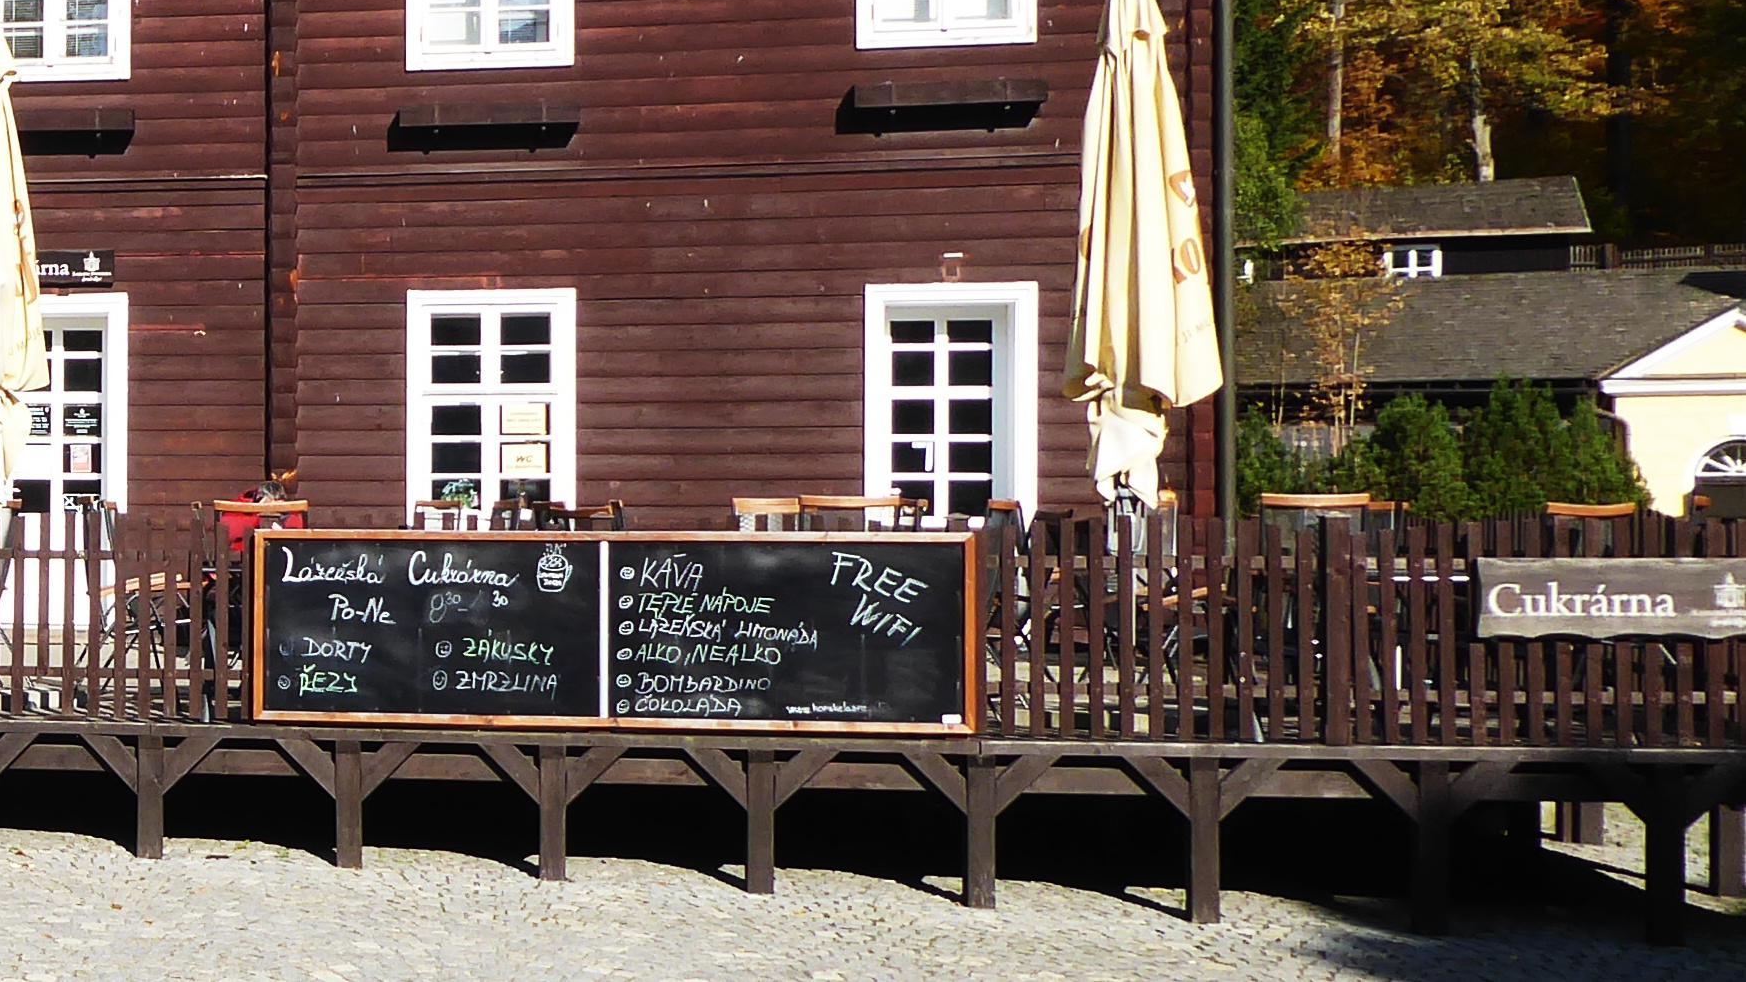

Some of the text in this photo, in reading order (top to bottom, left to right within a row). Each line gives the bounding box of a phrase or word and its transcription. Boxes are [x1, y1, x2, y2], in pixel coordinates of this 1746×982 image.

[639, 553, 703, 591] KÁVA
[830, 551, 929, 603] FREE
[1487, 581, 1677, 617] Cukrárna
[849, 593, 923, 647] WIFI
[301, 629, 554, 665] DORTY ZÁKUSKY
[455, 670, 558, 700] ZMRZLINA
[635, 672, 771, 694] BOMBARDINO
